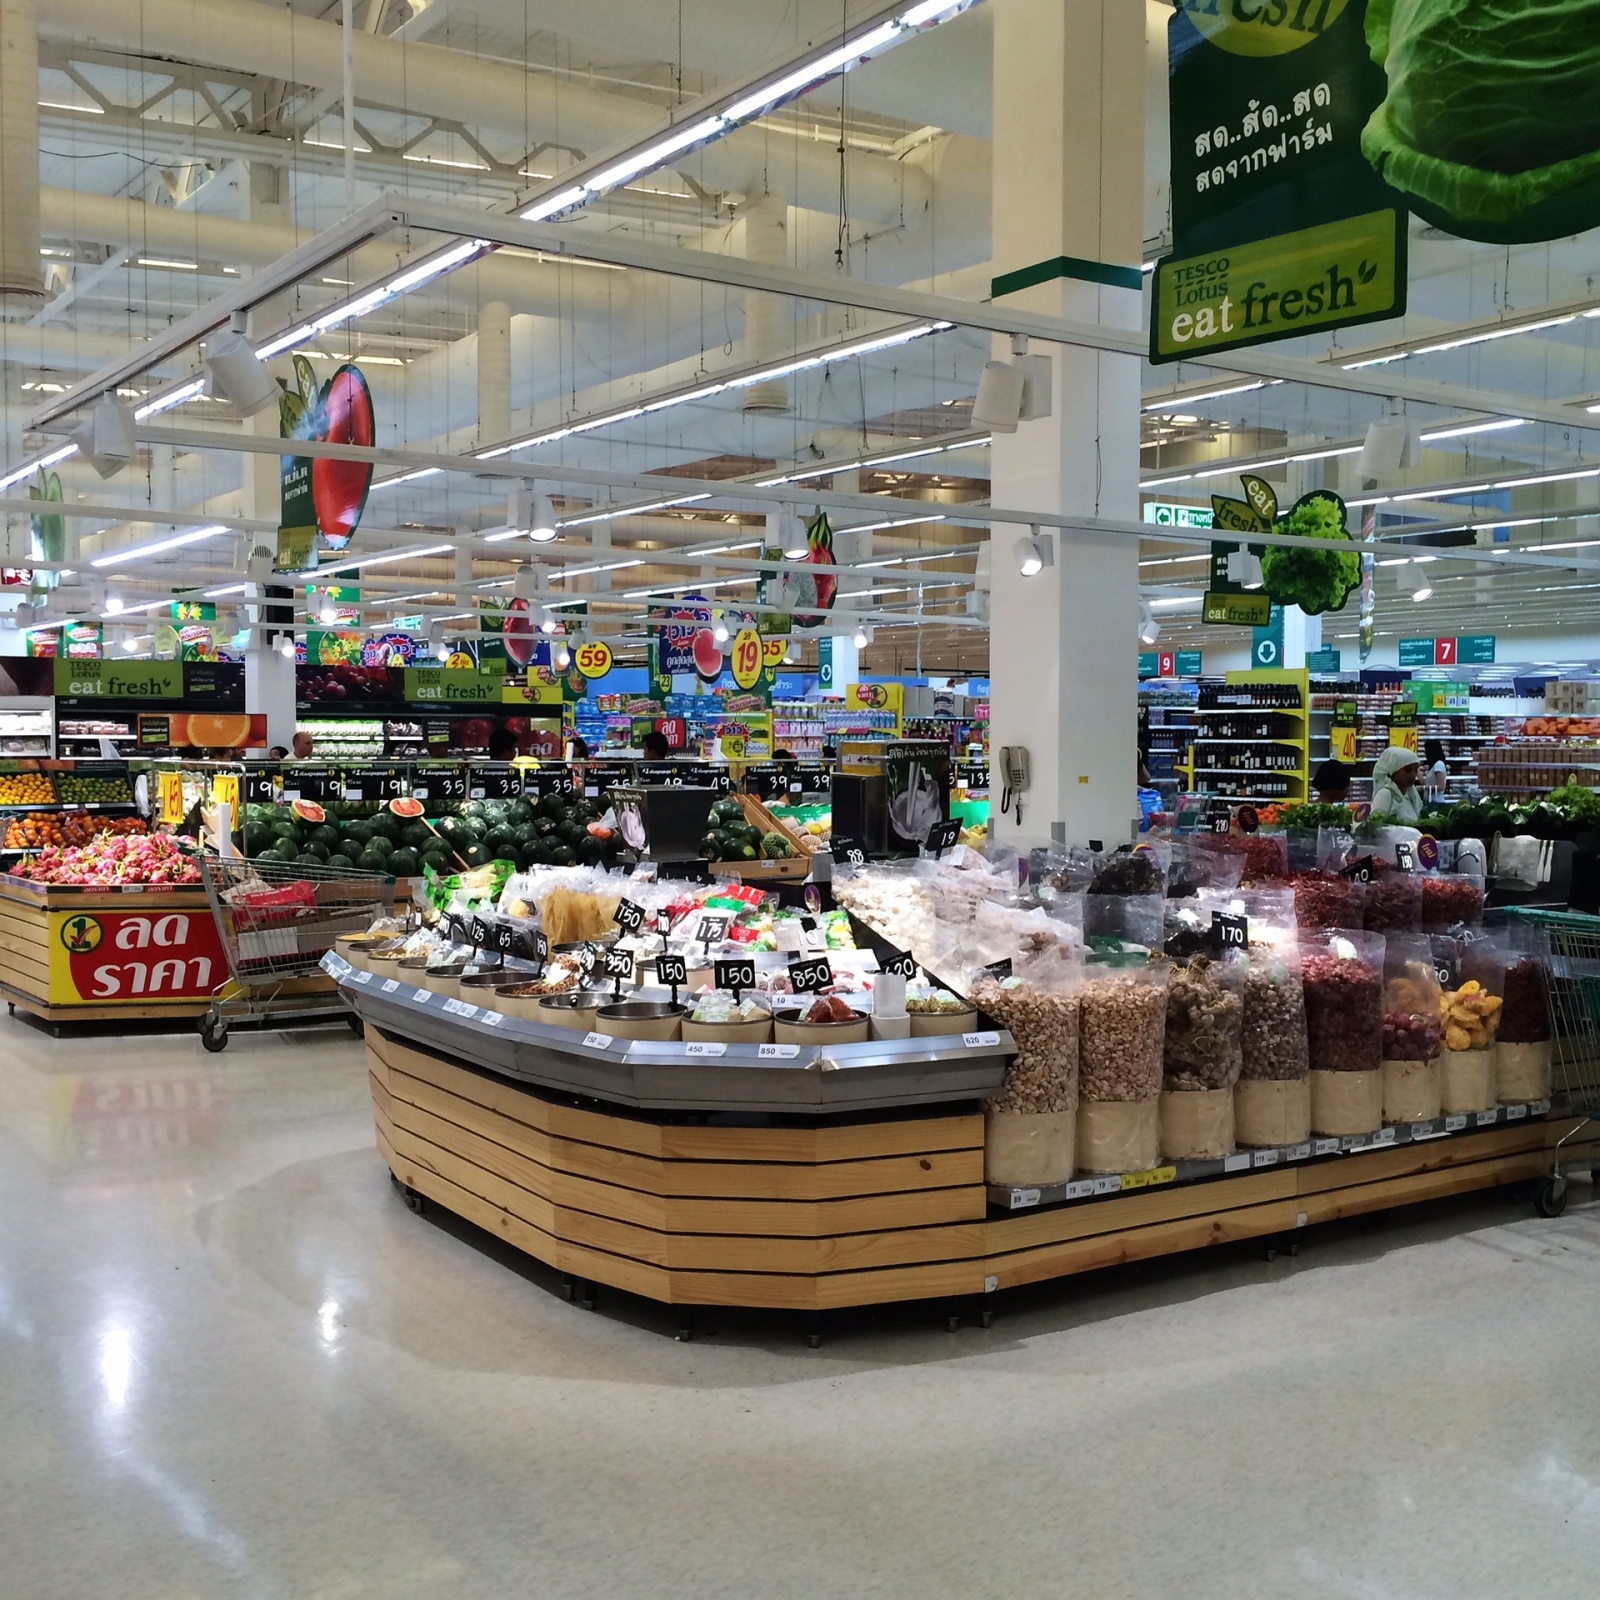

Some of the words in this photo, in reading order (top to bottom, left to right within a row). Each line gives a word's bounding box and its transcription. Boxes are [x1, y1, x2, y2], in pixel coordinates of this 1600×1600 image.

[1196, 117, 1333, 192] สดจากฟาร์ม
[1174, 257, 1230, 283] TESCO
[1176, 281, 1229, 306] Lotus
[1171, 297, 1234, 342] eat
[1241, 265, 1356, 328] fresh
[1247, 480, 1275, 515] eat
[1216, 501, 1260, 533] fresh
[1208, 608, 1226, 620] eat
[1227, 607, 1259, 622] fresh
[580, 649, 607, 668] 59
[738, 641, 758, 673] 19
[1441, 643, 1451, 660] 7
[1163, 657, 1170, 671] 9
[71, 670, 101, 678] Lotus
[661, 674, 670, 689] 23
[69, 681, 103, 694] eat
[107, 678, 163, 695] fresh
[417, 687, 443, 698] eat
[446, 684, 486, 699] fresh
[250, 782, 272, 798] 19
[321, 781, 341, 796] 19
[381, 780, 401, 796] 19
[443, 780, 465, 795] 35
[500, 780, 520, 794] 35
[552, 779, 573, 794] 35
[770, 776, 788, 790] 39
[813, 775, 830, 789] 39
[941, 831, 956, 846] 19
[847, 849, 864, 864] 88
[619, 906, 641, 927] 150
[115, 914, 190, 950] ลด
[472, 926, 486, 942] 125
[500, 932, 511, 947] 65
[1221, 925, 1244, 944] 170
[607, 955, 631, 974] 350
[660, 963, 684, 981] 150
[91, 956, 212, 997] ราคา
[720, 967, 753, 985] 150
[792, 964, 830, 988] 850
[966, 1037, 979, 1045] 620
[1098, 1182, 1106, 1190] 19
